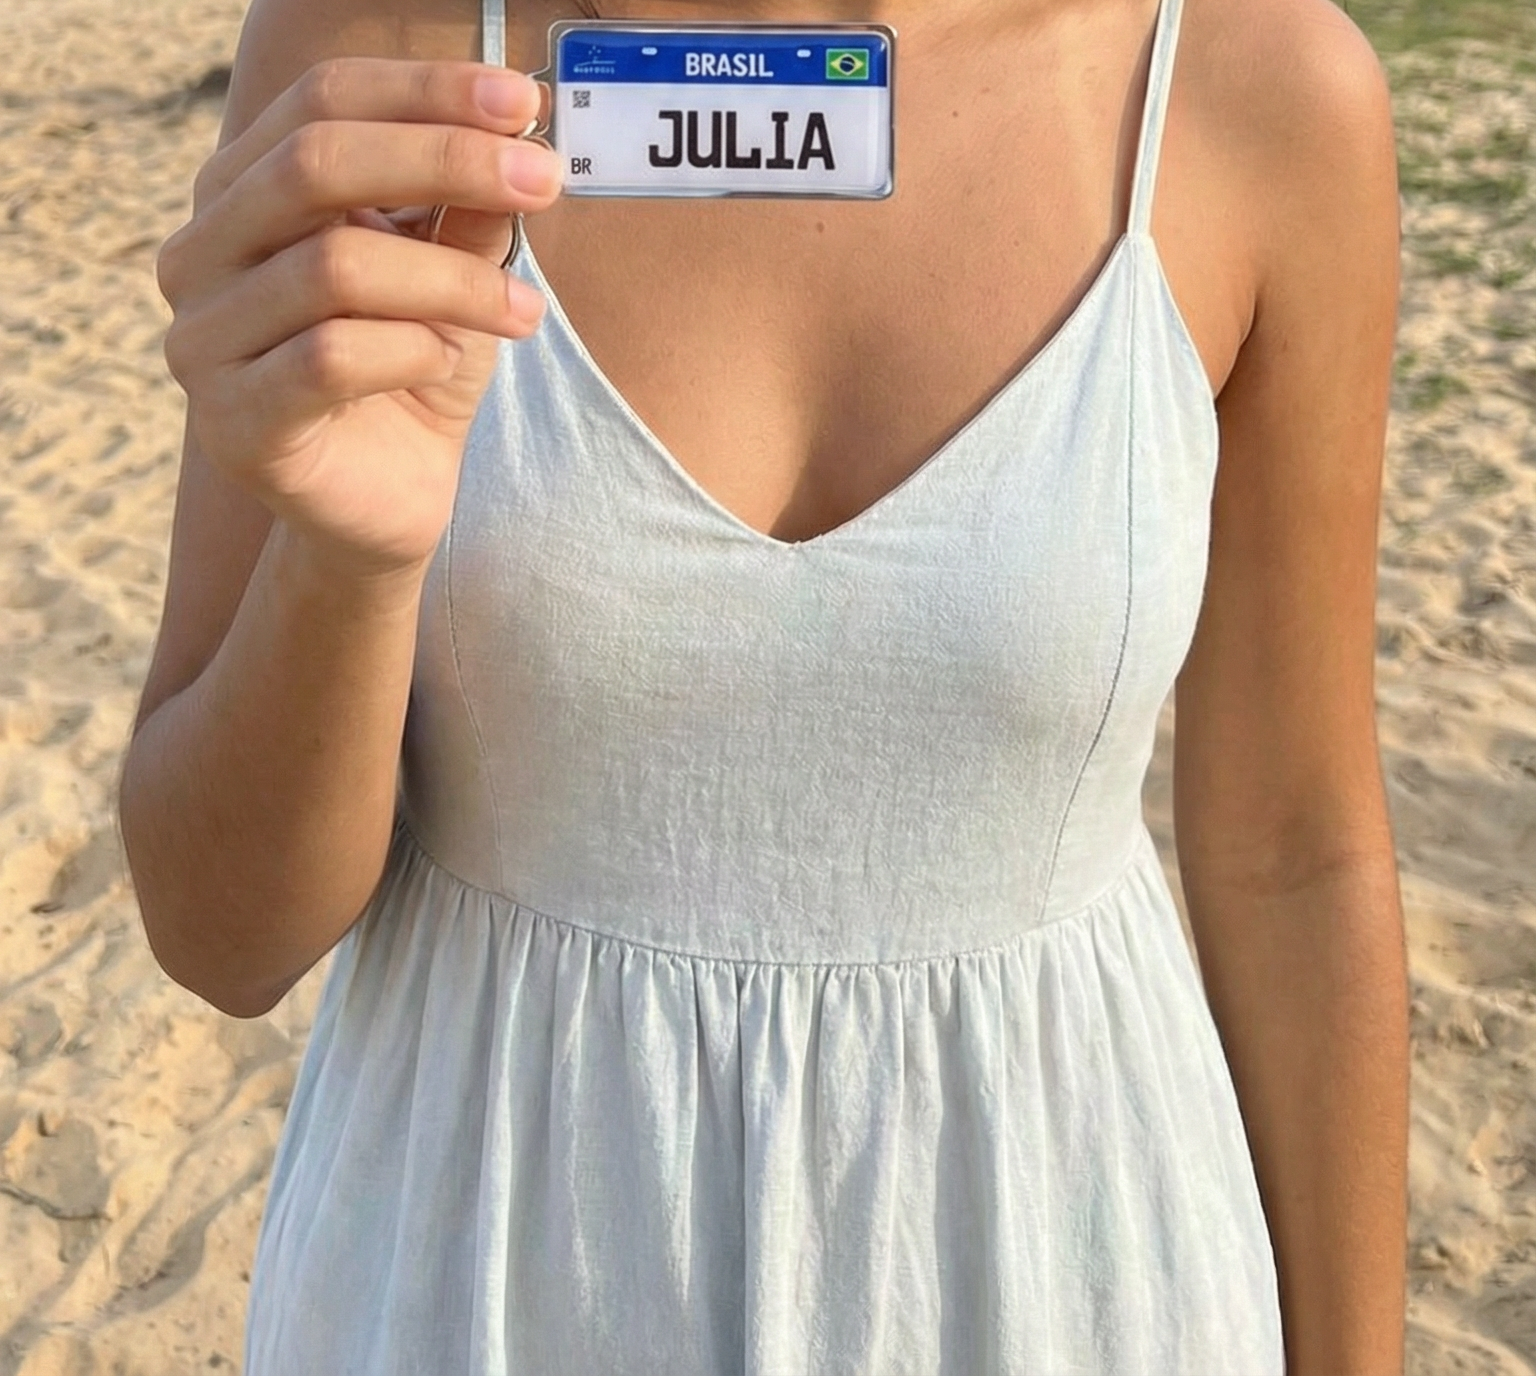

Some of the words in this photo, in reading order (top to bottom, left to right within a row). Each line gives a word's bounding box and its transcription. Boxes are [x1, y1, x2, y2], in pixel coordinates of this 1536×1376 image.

[685, 52, 774, 77] BRASIL
[649, 110, 835, 170] JULIA
[570, 157, 592, 175] BR
